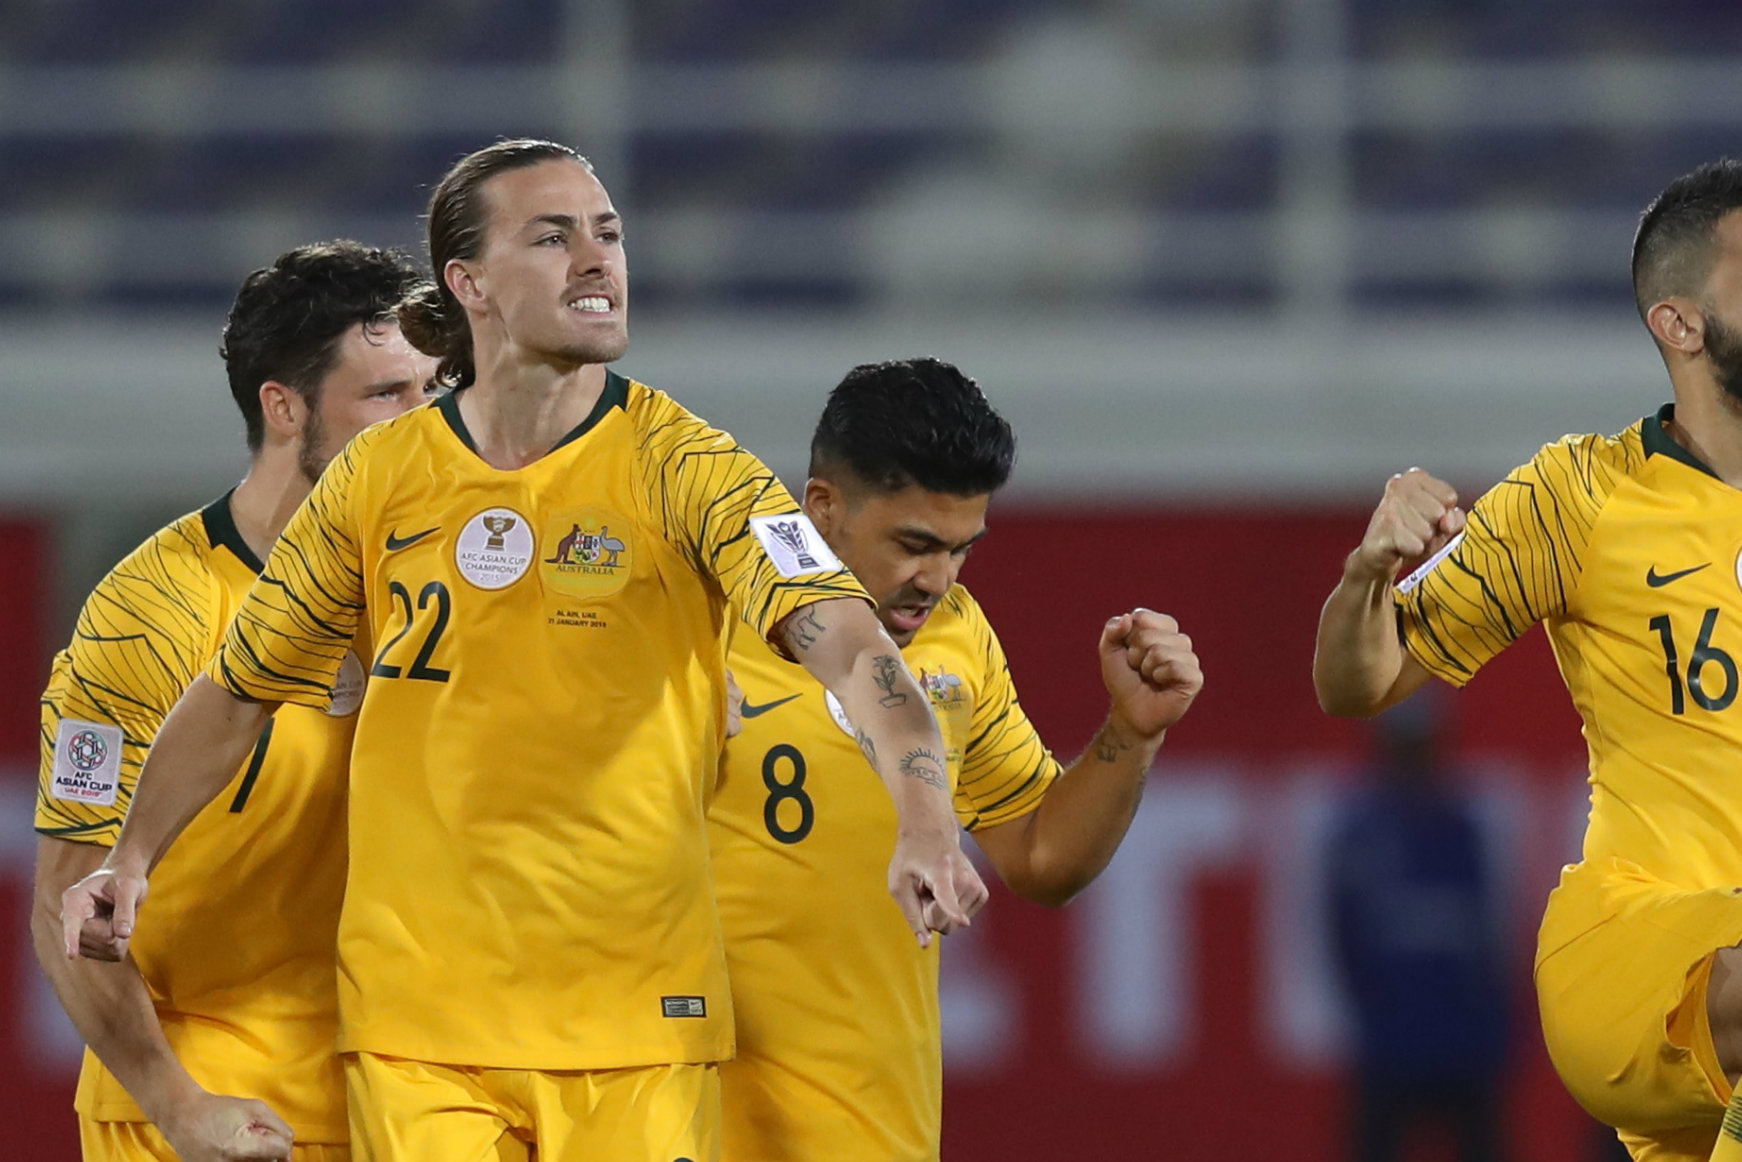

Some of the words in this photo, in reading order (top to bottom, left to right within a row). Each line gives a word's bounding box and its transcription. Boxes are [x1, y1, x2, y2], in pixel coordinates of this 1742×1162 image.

[461, 552, 478, 561] AFC
[480, 554, 506, 563] ASIAN
[508, 557, 527, 565] CUP
[465, 563, 518, 574] CHAMPIONS
[556, 565, 614, 575] AUSTRALIA
[370, 582, 450, 683] 22
[1650, 608, 1739, 715] 16
[75, 771, 93, 780] AFC
[56, 776, 87, 788] ASIAN
[89, 781, 112, 791] CUP
[762, 744, 814, 844] 8
